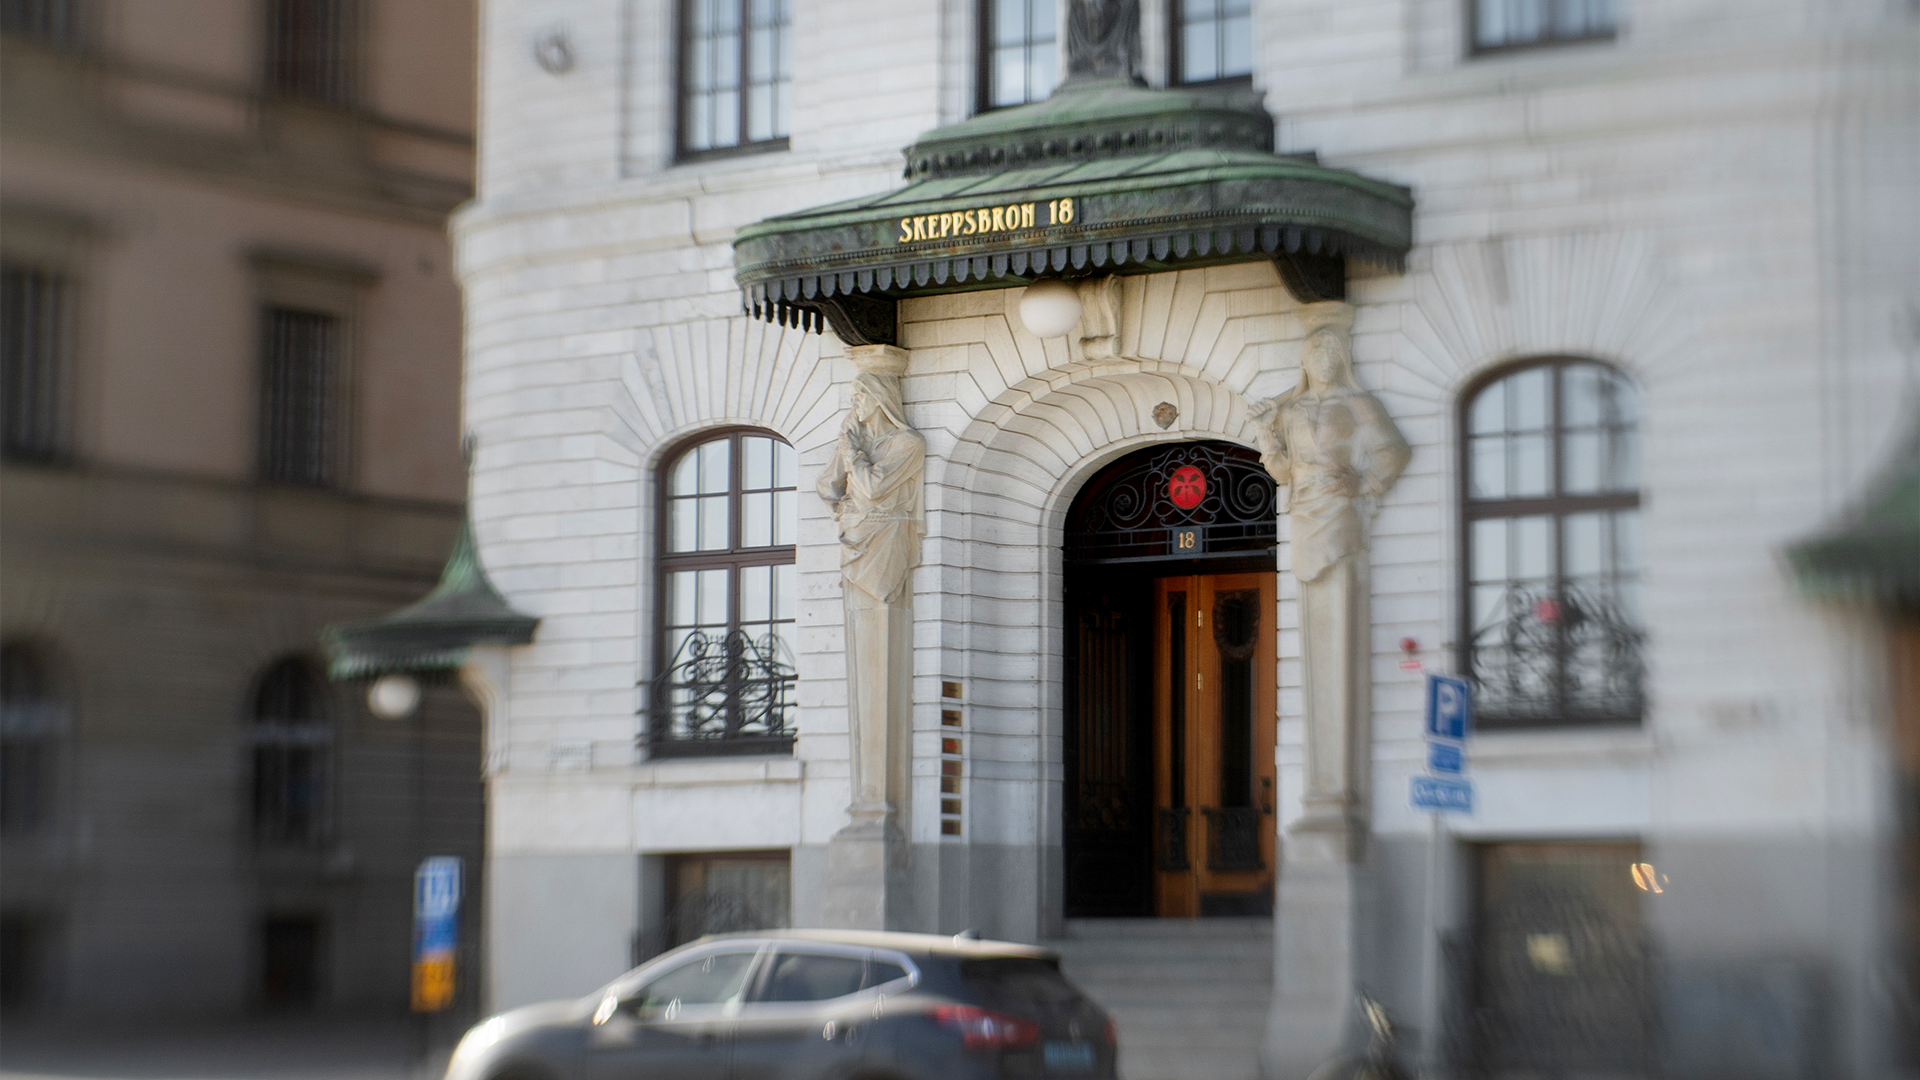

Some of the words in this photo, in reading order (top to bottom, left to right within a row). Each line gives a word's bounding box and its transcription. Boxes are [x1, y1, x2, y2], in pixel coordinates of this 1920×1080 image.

[899, 202, 1035, 243] SKEPPSBRON
[1049, 197, 1074, 225] 18
[1178, 531, 1195, 549] 18
[1436, 681, 1456, 732] P
